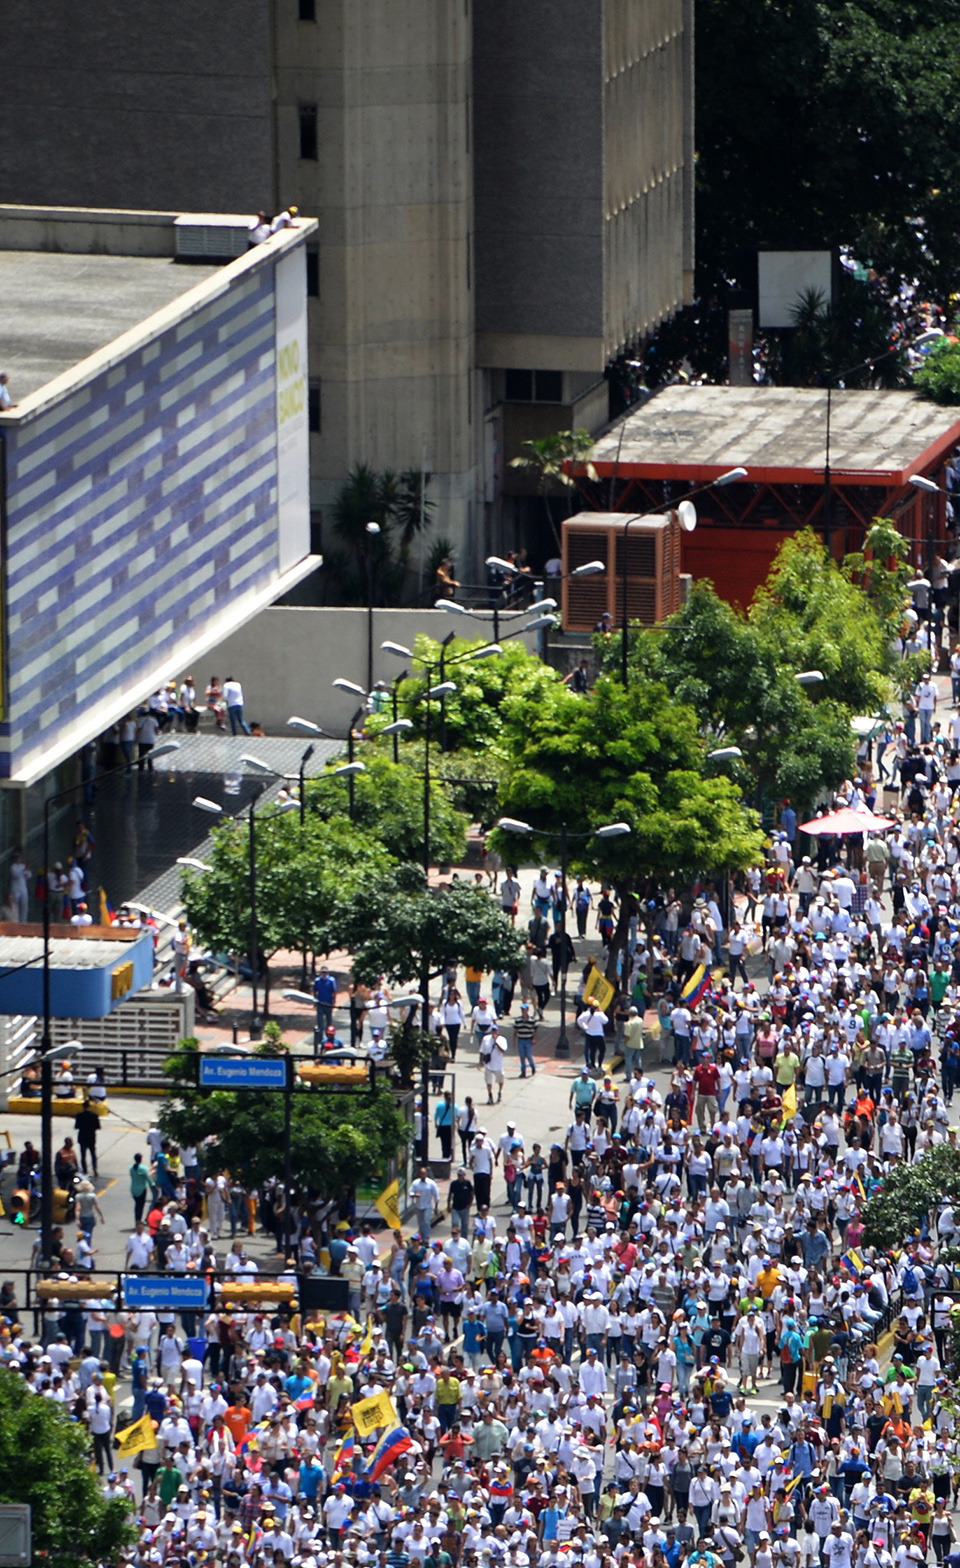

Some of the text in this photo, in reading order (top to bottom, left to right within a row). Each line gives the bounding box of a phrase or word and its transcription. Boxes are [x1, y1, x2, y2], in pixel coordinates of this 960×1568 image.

[204, 1066, 282, 1078] Av. Eugenio Mendoza
[141, 1286, 170, 1298] Eugenio
[171, 1286, 202, 1297] Mendoza
